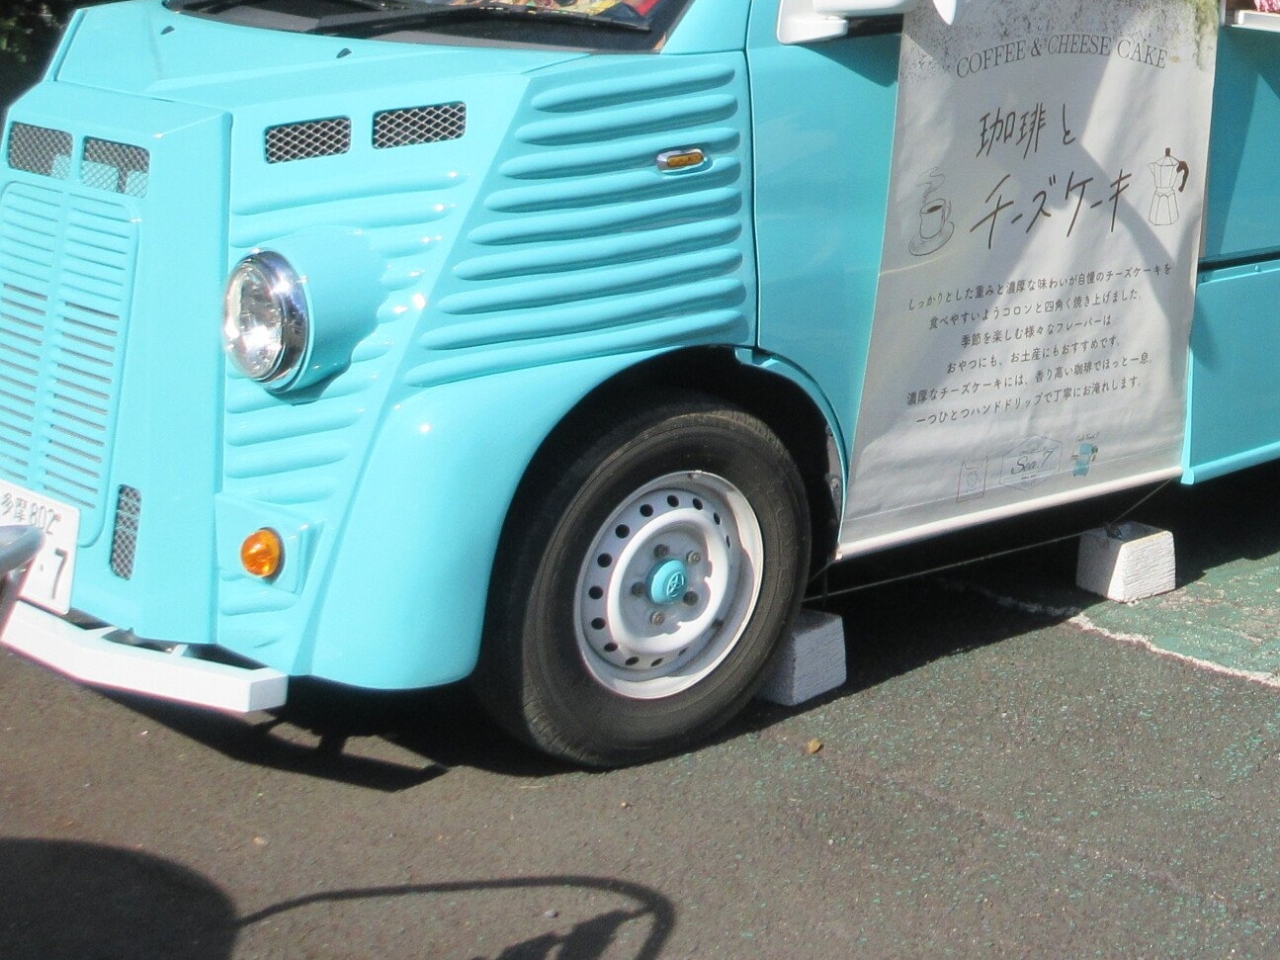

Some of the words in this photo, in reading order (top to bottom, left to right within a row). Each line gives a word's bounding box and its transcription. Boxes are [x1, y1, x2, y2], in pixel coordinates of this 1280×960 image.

[956, 39, 1027, 79] COFFEE
[1030, 38, 1043, 57] &
[1047, 34, 1112, 57] CHEESE
[1116, 39, 1168, 69] CAKE
[969, 168, 1133, 250] チーズケーキ
